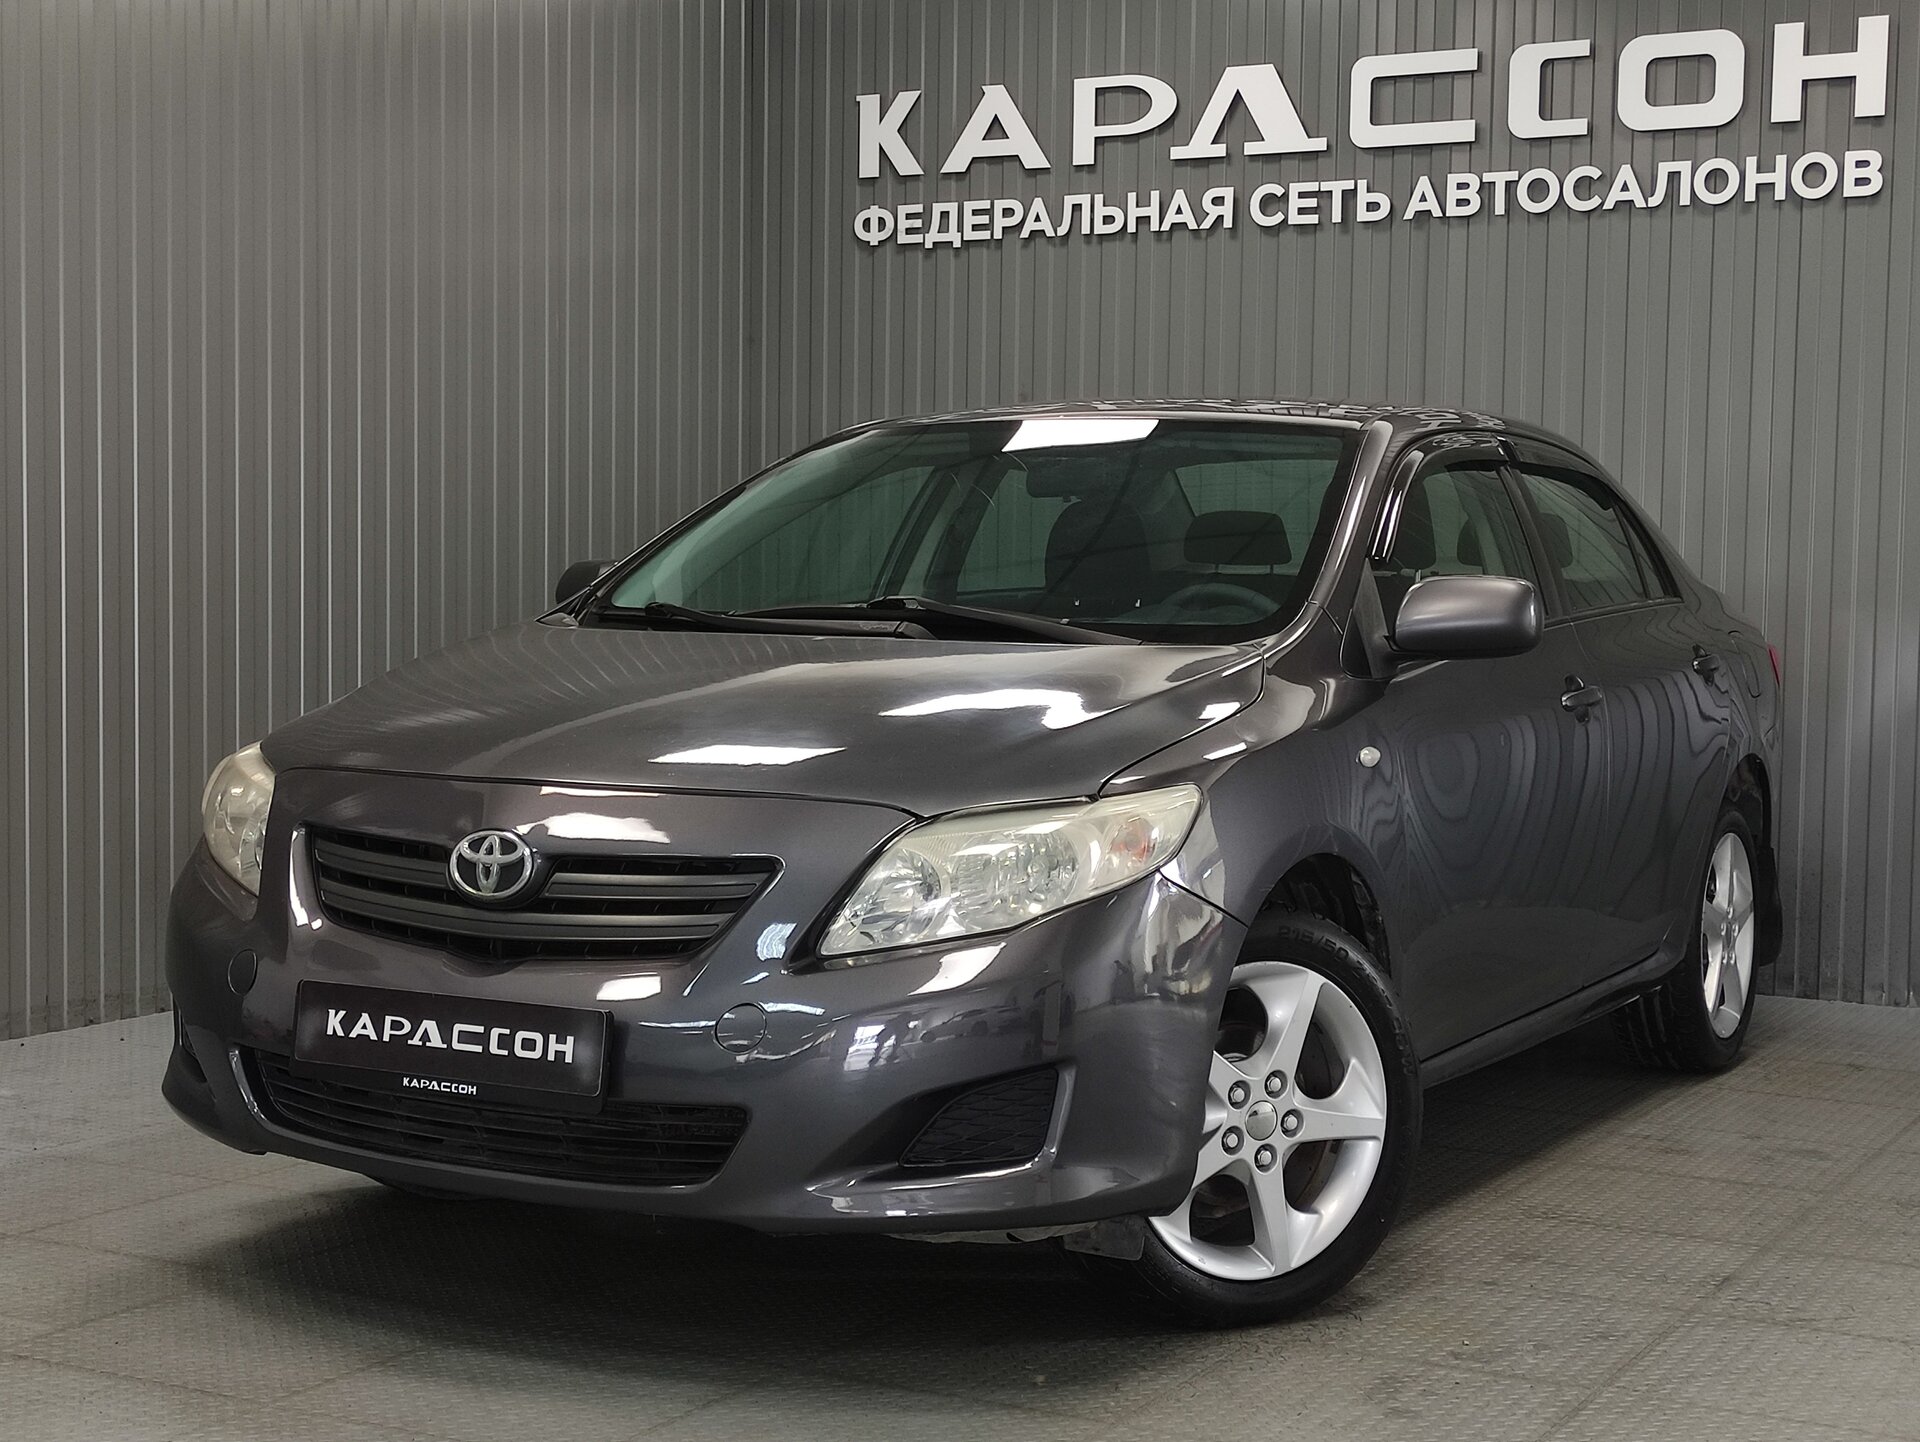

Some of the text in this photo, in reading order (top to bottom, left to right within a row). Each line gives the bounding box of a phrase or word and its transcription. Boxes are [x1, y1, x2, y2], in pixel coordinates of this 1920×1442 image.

[854, 149, 1884, 249] ФЕДЕРАЛЬНАЯ СЕТЬ АВТОСАЛОНОВ
